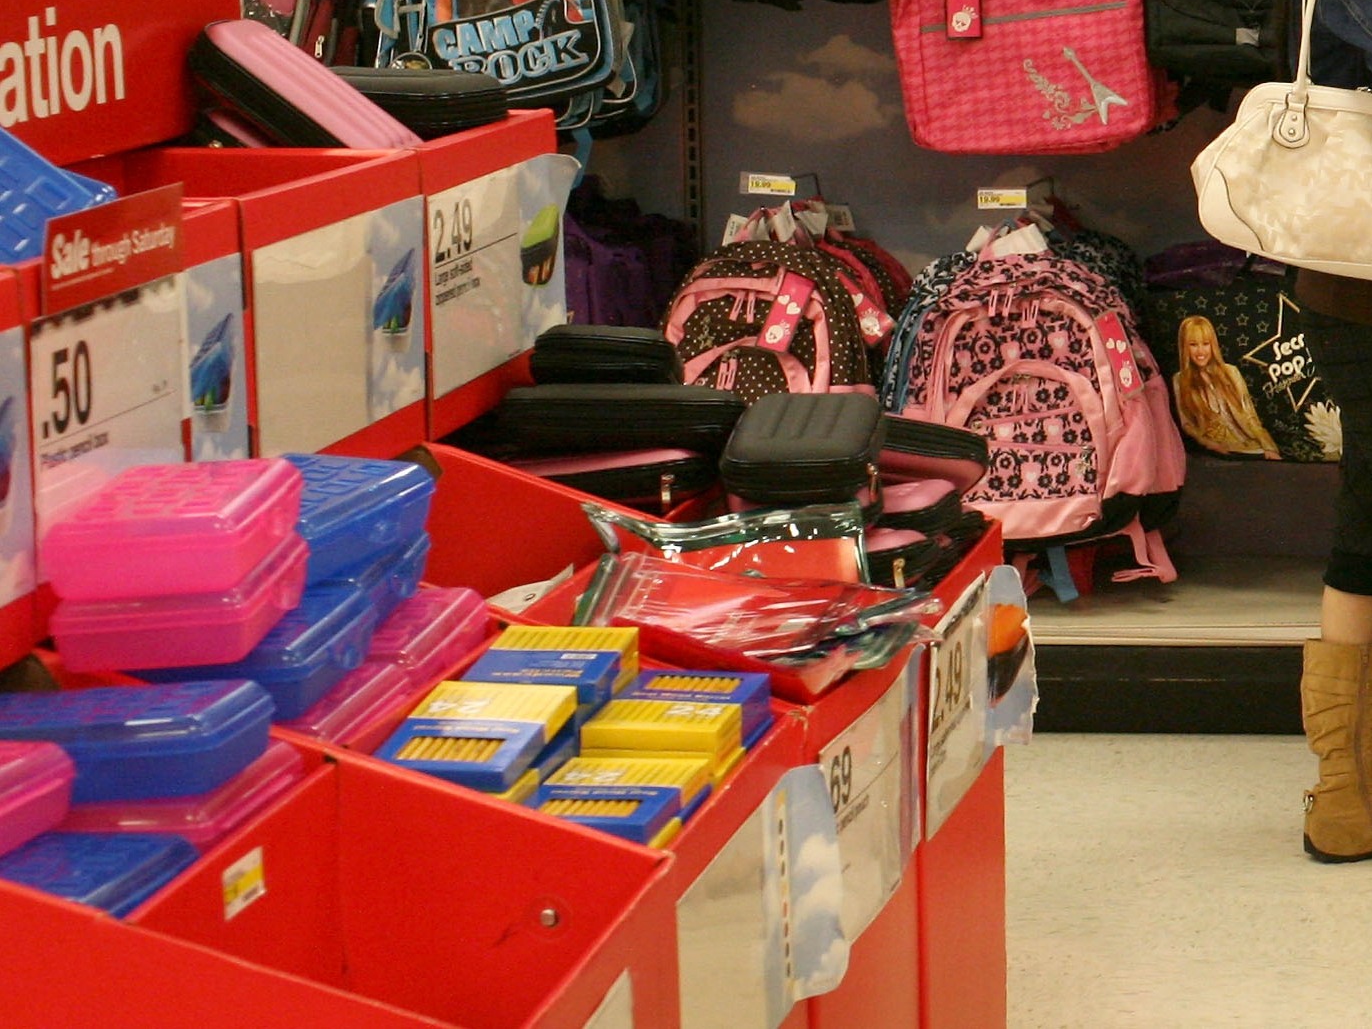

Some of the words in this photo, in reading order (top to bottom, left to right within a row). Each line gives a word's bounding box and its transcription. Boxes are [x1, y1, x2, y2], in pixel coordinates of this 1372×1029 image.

[0, 6, 125, 128] ation
[432, 8, 537, 61] CAMP
[51, 228, 91, 280] Sale
[434, 199, 472, 264] 2.49
[42, 339, 92, 440] .50
